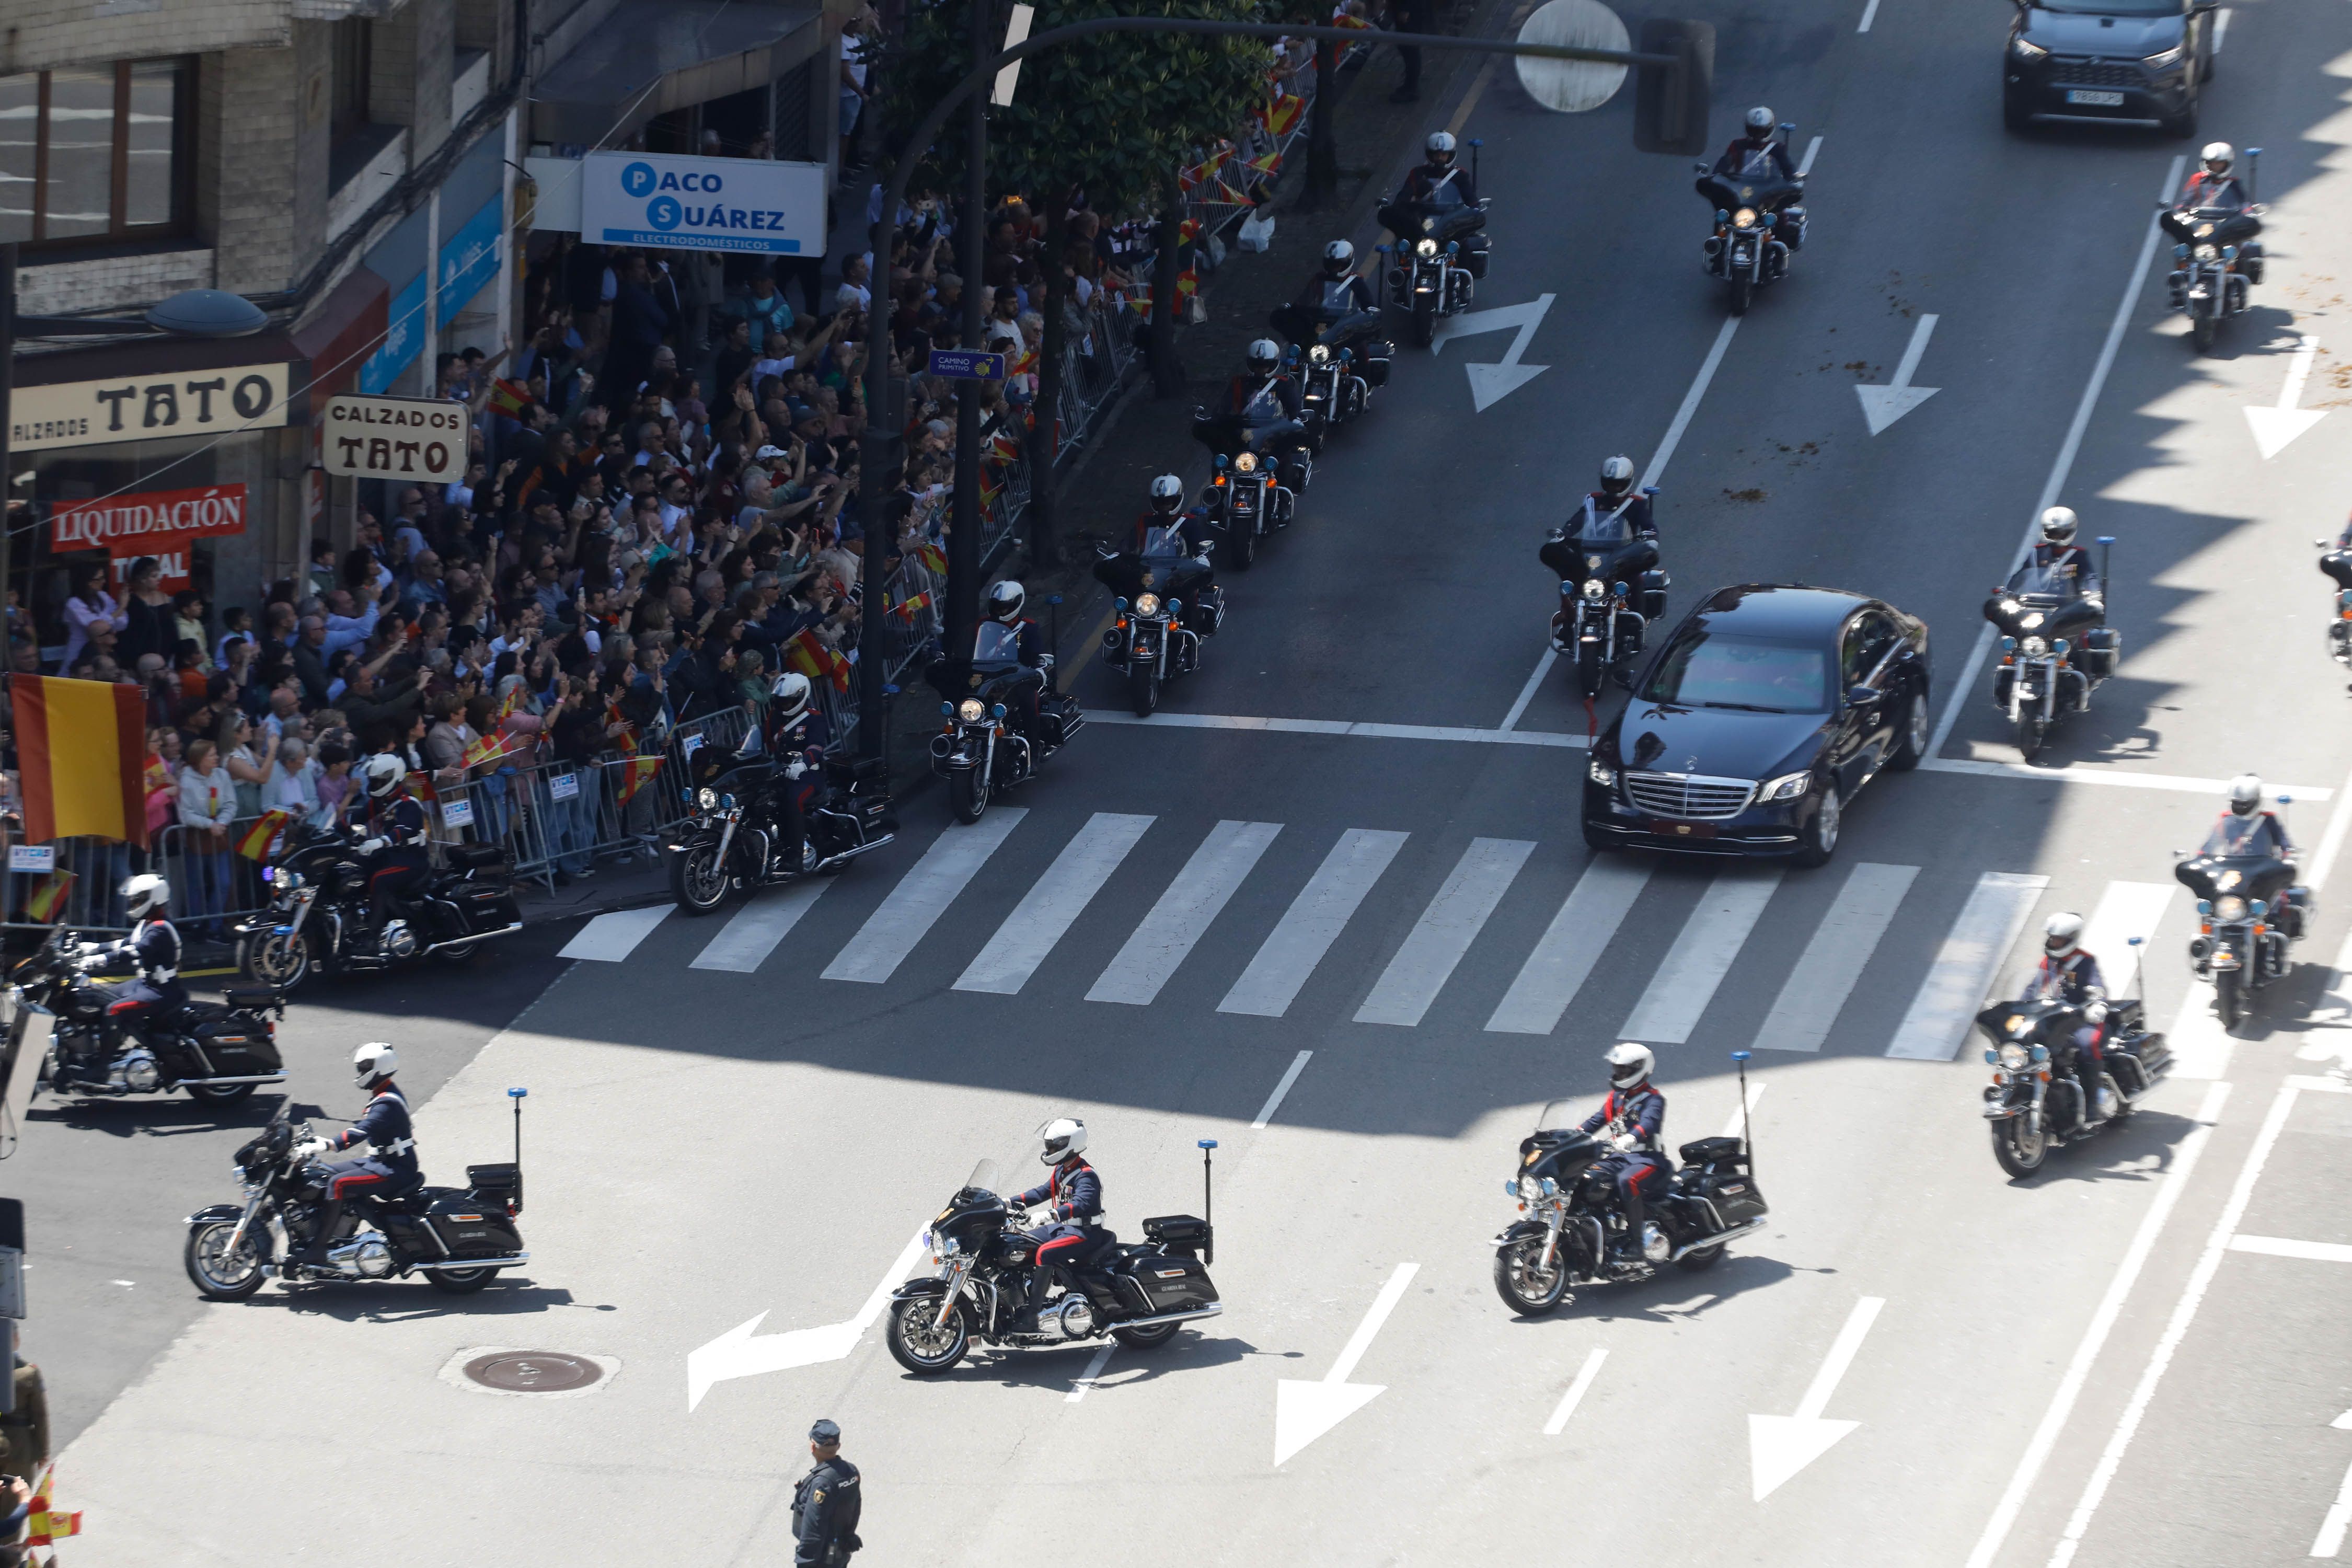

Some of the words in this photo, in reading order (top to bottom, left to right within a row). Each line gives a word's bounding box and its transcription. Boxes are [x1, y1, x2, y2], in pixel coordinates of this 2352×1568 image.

[632, 171, 722, 193] PACO
[658, 204, 785, 230] SUÁREZ
[633, 234, 770, 250] ELECTRODOMÉSTICOS
[938, 357, 970, 365] CAMINO
[9, 419, 88, 441] ALZADOS
[98, 375, 273, 431] TATO
[332, 406, 459, 430] CALZADOS
[338, 436, 449, 474] TATO
[56, 489, 242, 546] LIQUIDACIÓN
[112, 552, 188, 583] TAL
